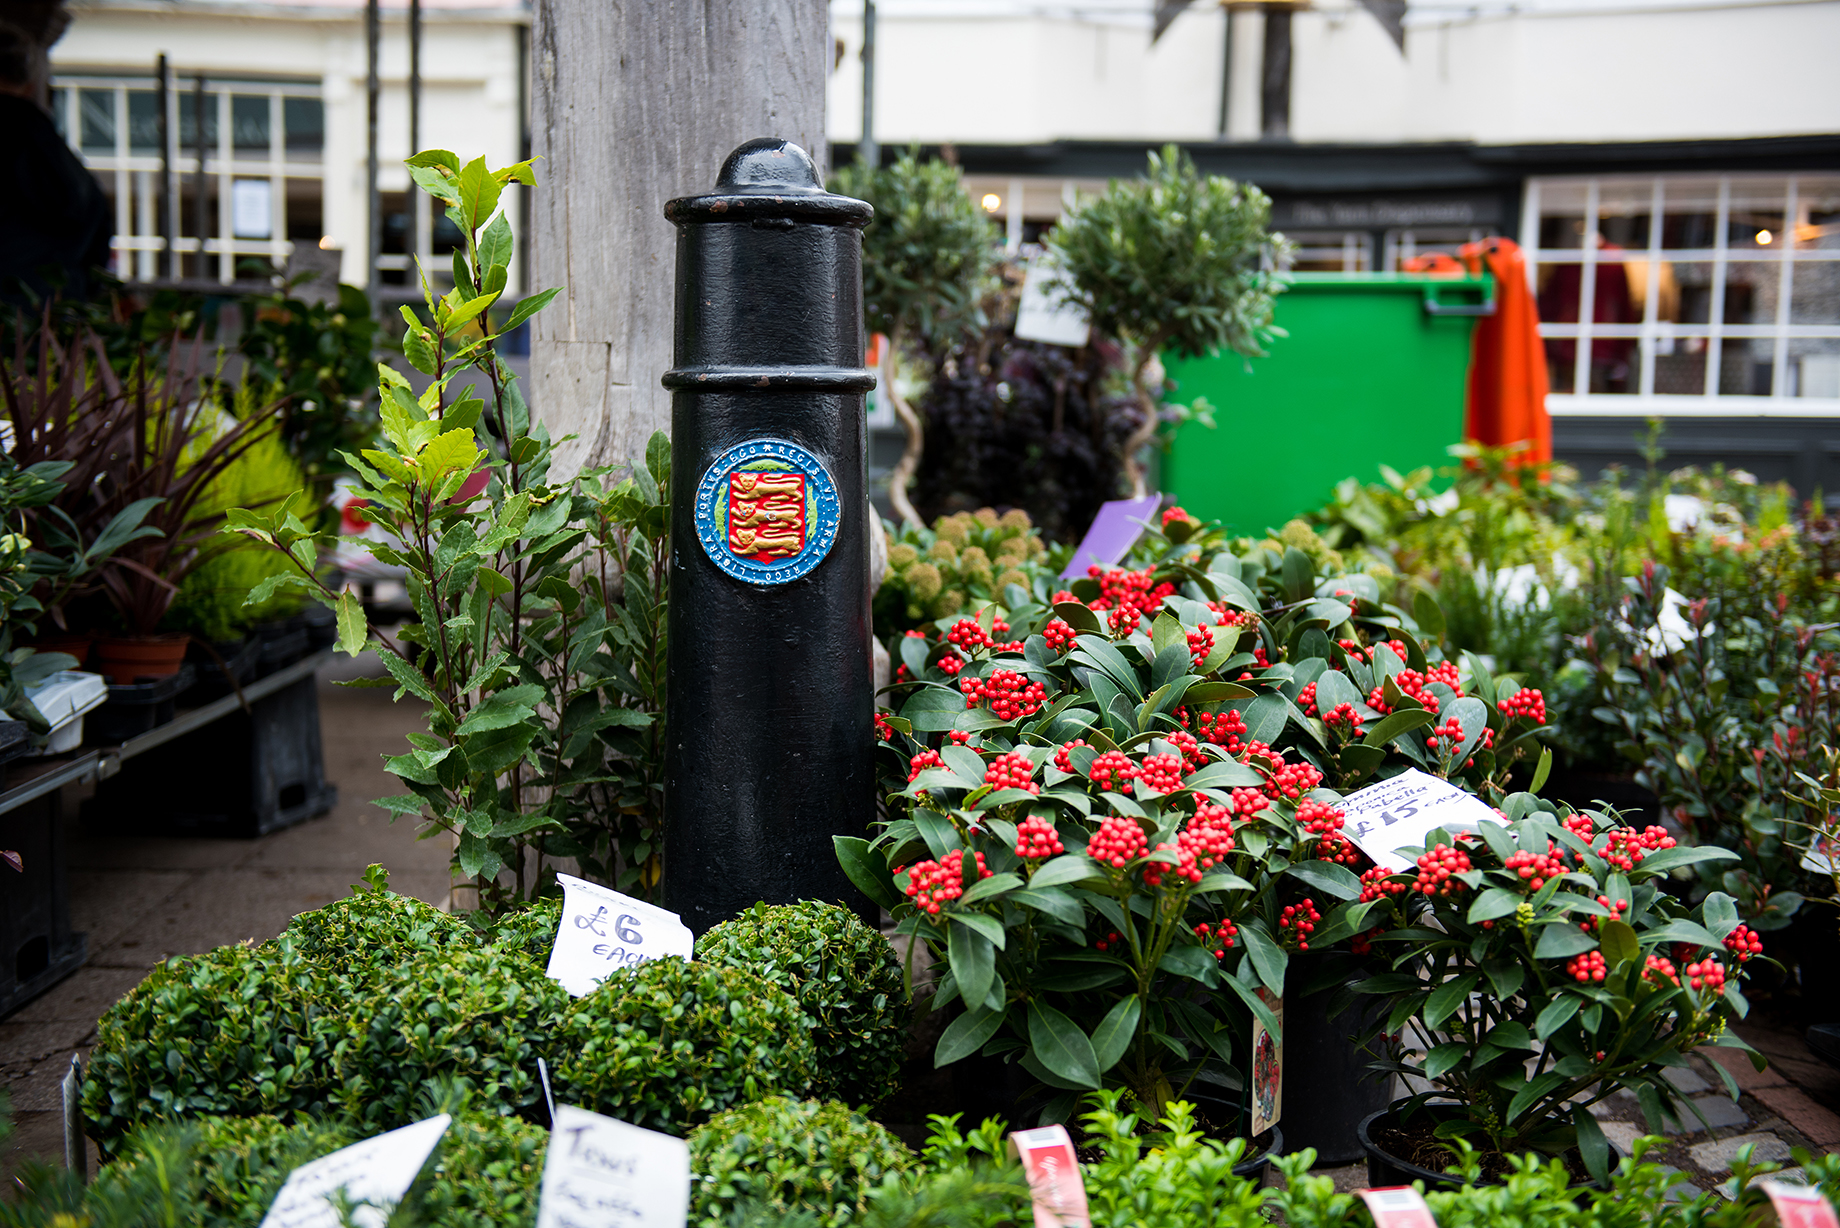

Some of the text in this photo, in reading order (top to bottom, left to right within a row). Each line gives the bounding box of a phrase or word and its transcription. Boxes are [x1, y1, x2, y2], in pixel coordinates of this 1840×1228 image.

[729, 447, 756, 462] EGO
[813, 520, 835, 557] ARMA
[573, 905, 644, 945] £6
